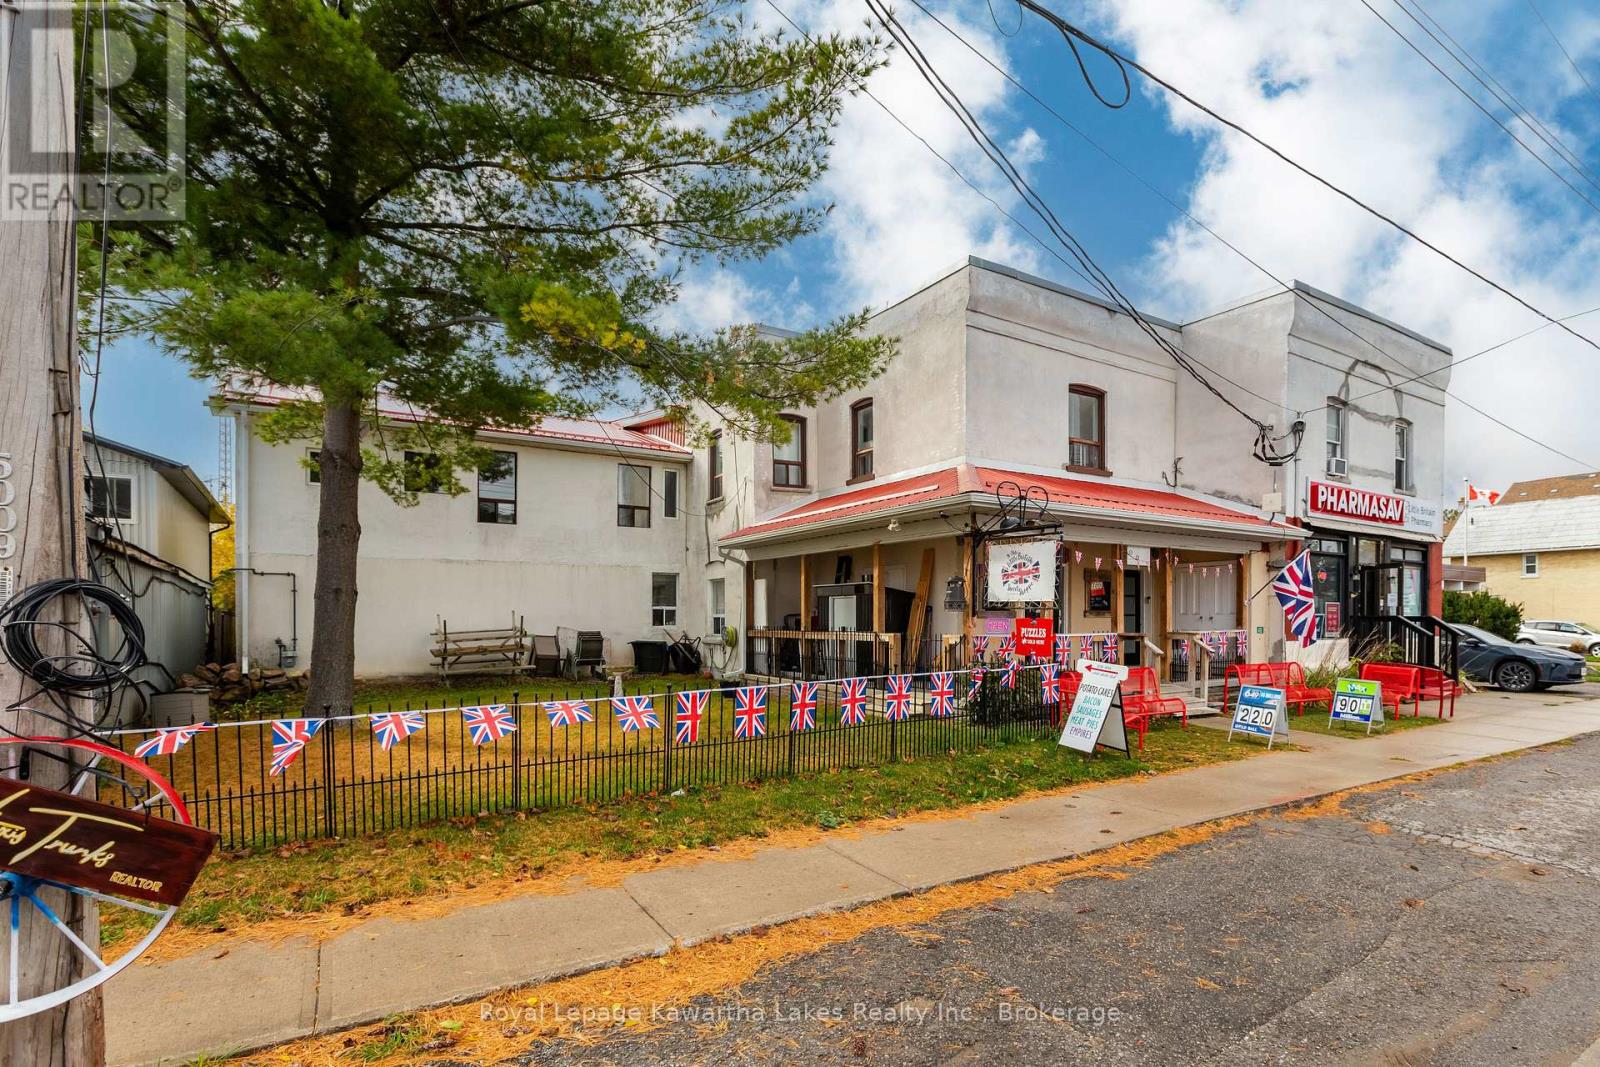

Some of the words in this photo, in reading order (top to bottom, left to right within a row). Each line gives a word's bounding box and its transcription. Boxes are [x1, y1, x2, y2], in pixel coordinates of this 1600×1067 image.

[1020, 627, 1047, 638] PUZZLES
[1079, 683, 1098, 696] POTATO
[1083, 696, 1102, 707] BACON
[1075, 705, 1104, 720] SAUSAGES
[1070, 715, 1085, 727] MEAT
[1086, 718, 1101, 731] PIES
[1069, 727, 1094, 740] EMPIRES
[109, 870, 163, 893] REALTOR
